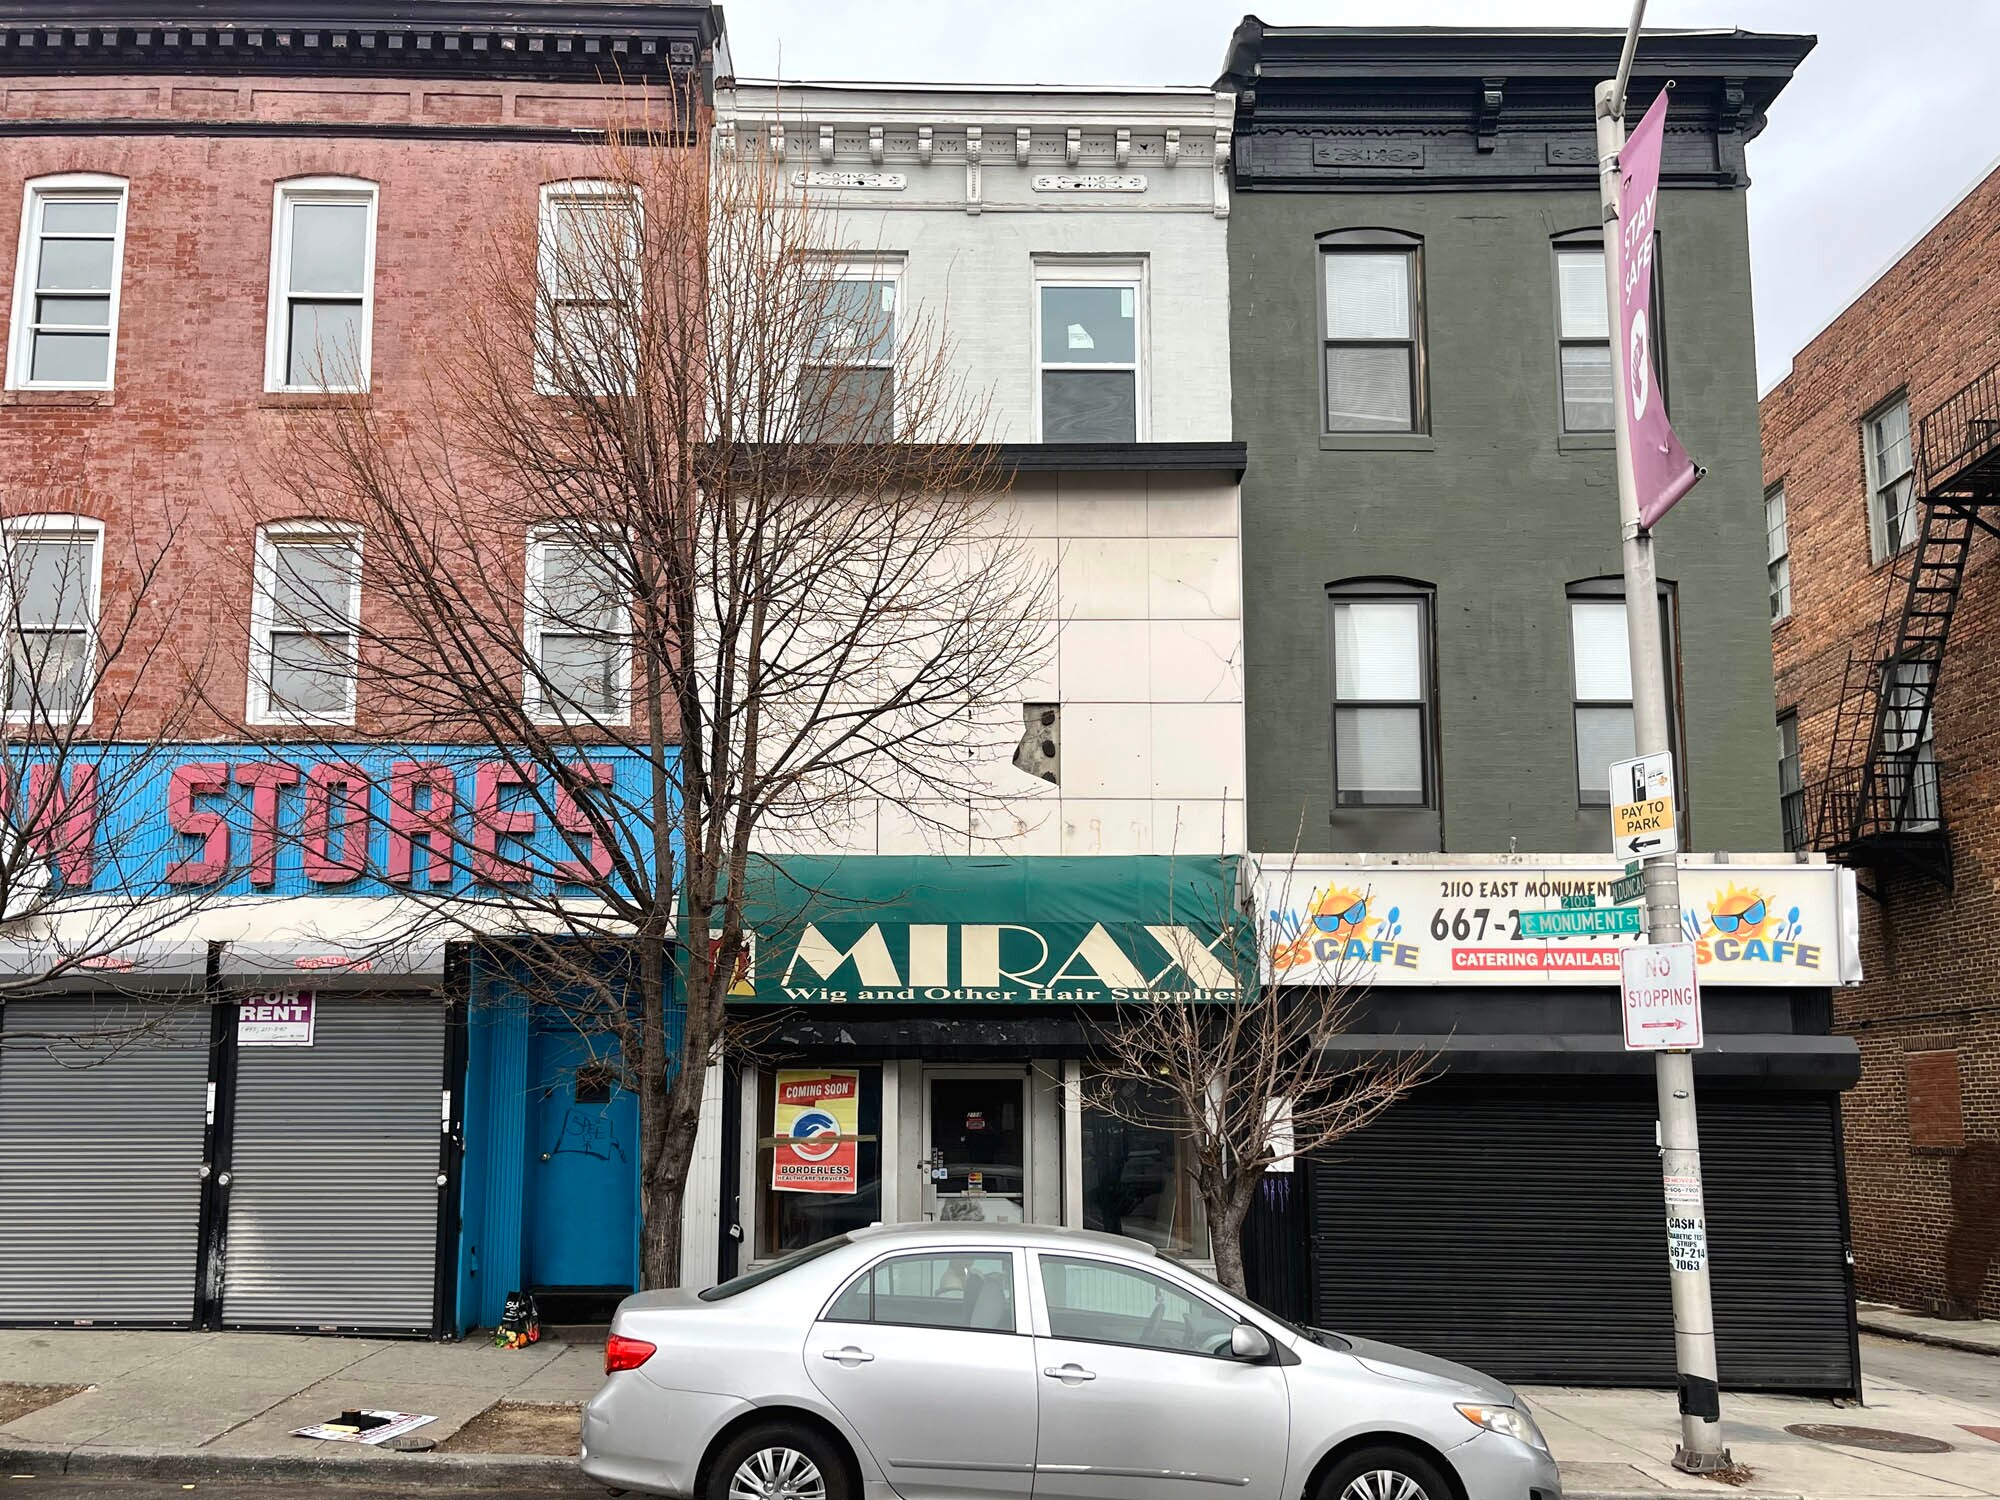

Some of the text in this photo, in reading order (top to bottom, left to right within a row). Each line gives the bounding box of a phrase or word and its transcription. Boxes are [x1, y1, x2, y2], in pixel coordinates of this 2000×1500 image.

[1625, 186, 1656, 260] STAY
[1626, 231, 1653, 305] SAFE
[1621, 801, 1664, 820] PAY TO
[0, 761, 616, 886] N STORES
[1627, 816, 1661, 833] PARK
[1440, 881, 1474, 898] 2110
[1479, 881, 1519, 898] EAST
[1561, 895, 1590, 908] 2100
[1540, 911, 1625, 932] MONUMENT
[1627, 914, 1640, 926] ST
[780, 922, 1245, 989] MIRAX
[1455, 953, 1619, 967] CATERING AVAILABL
[1646, 957, 1671, 978] NO
[783, 988, 1242, 1003] Wig and Other Hair Supplies
[1629, 987, 1692, 1008] STOPPING
[240, 1006, 308, 1021] RENT
[786, 1082, 849, 1098] COMING SOON
[781, 1166, 850, 1174] BORDERLESS
[1676, 1240, 1697, 1248] STRIPS
[1676, 1259, 1700, 1271] 7063
